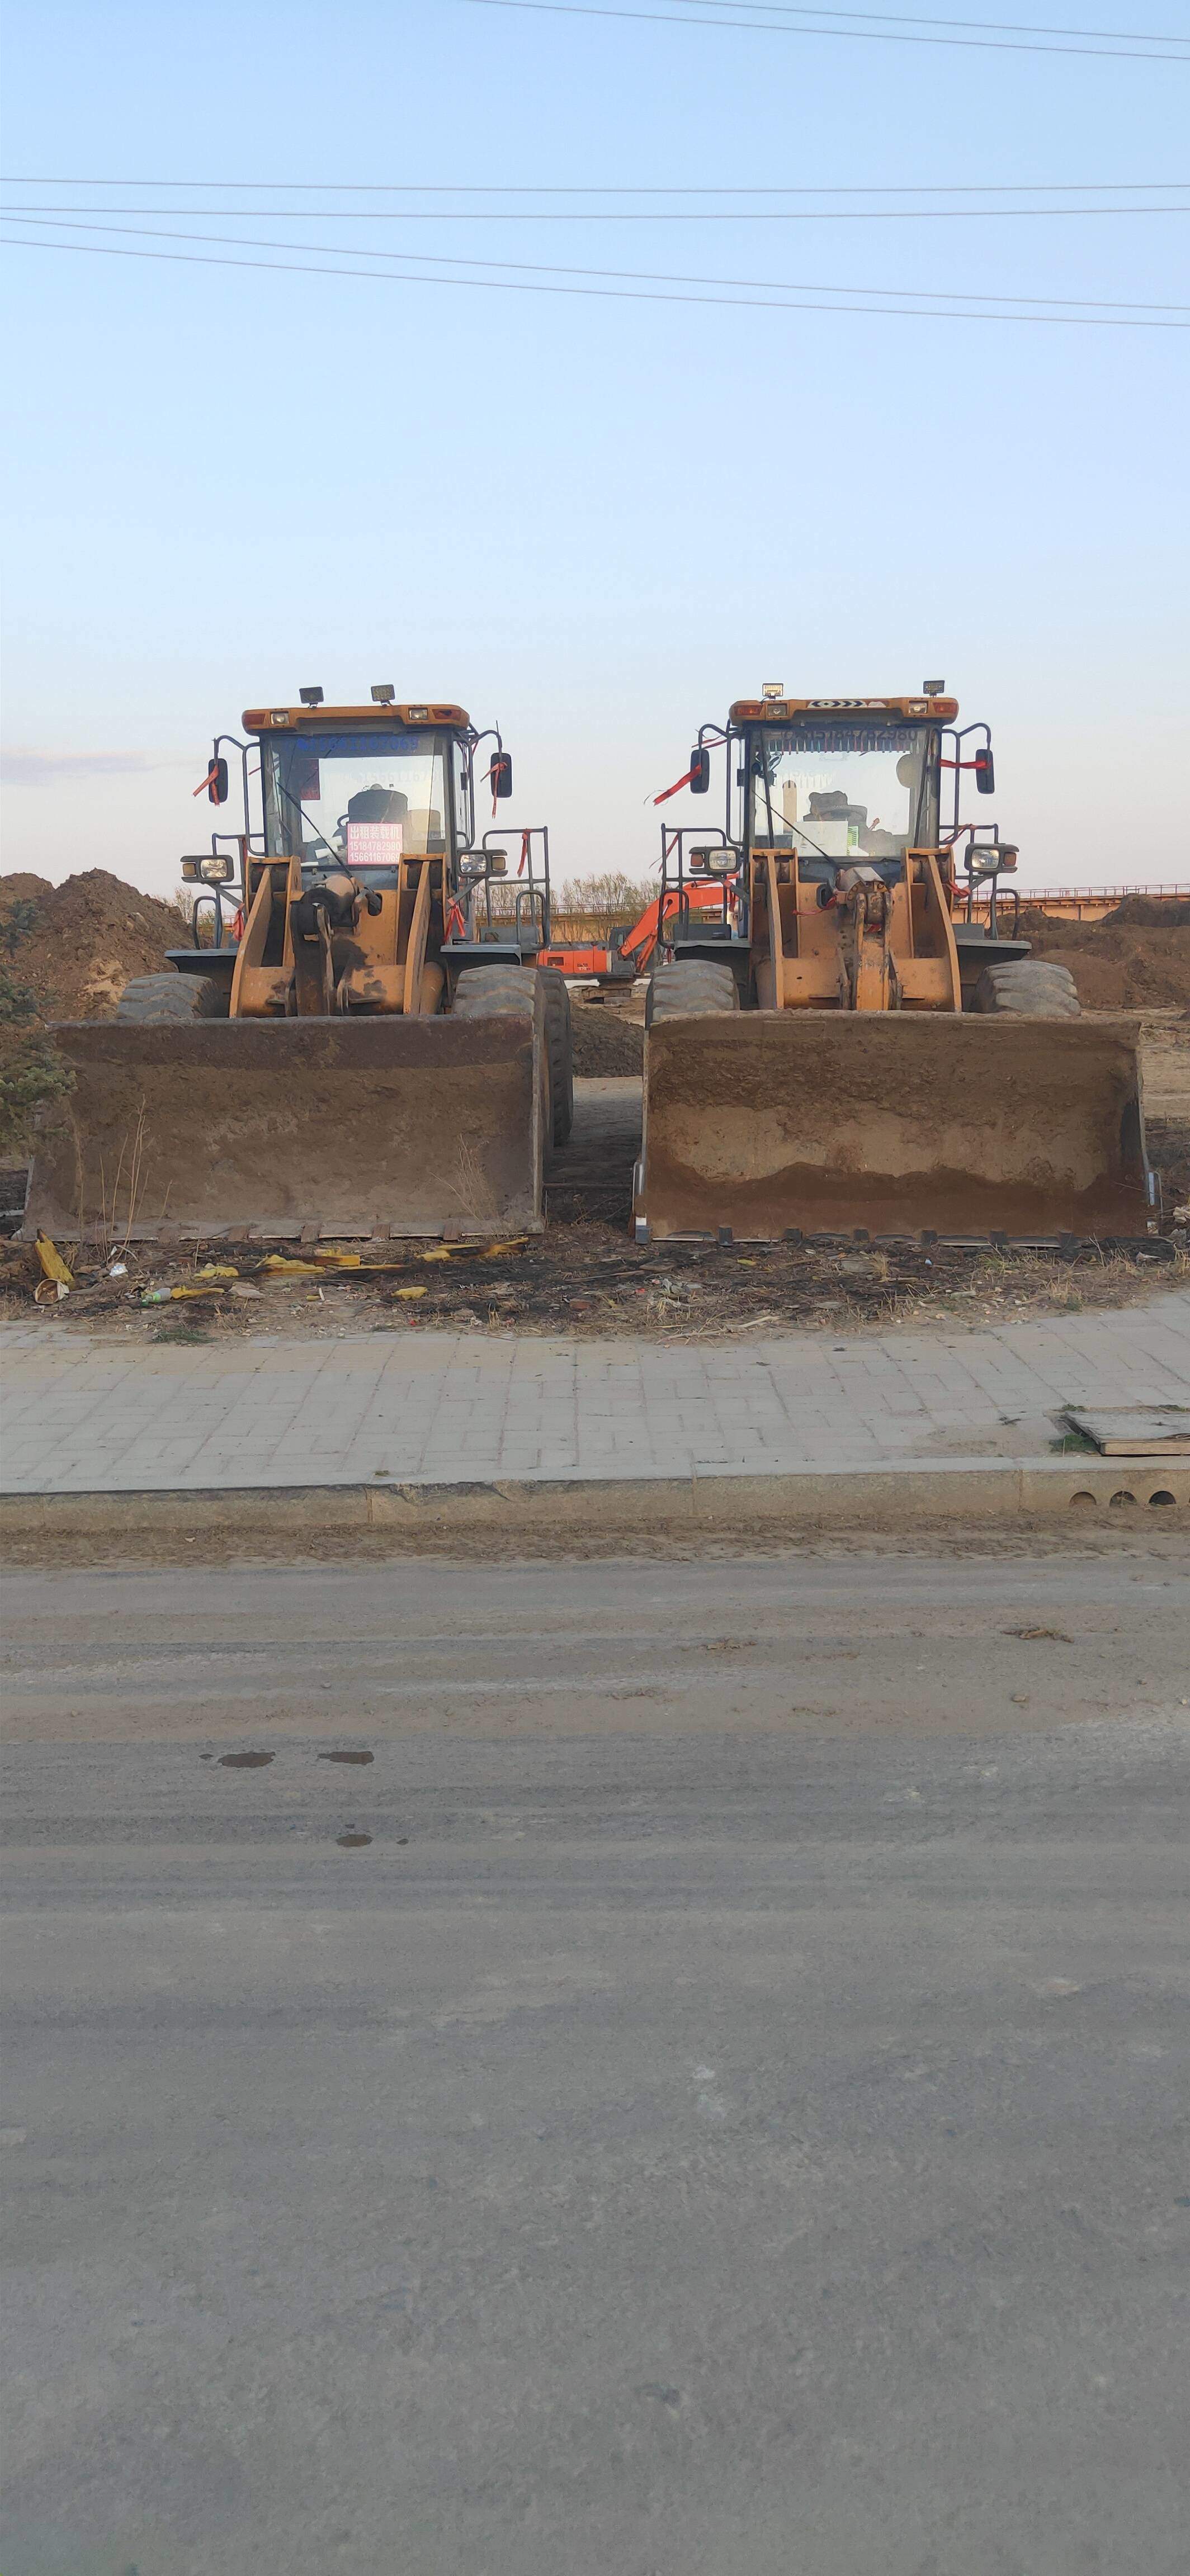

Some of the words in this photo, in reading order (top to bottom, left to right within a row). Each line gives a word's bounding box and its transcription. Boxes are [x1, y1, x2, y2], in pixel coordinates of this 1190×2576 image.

[350, 826, 400, 839] 出租装载机
[350, 841, 401, 850] 15184782980
[350, 852, 399, 862] 15661167069
